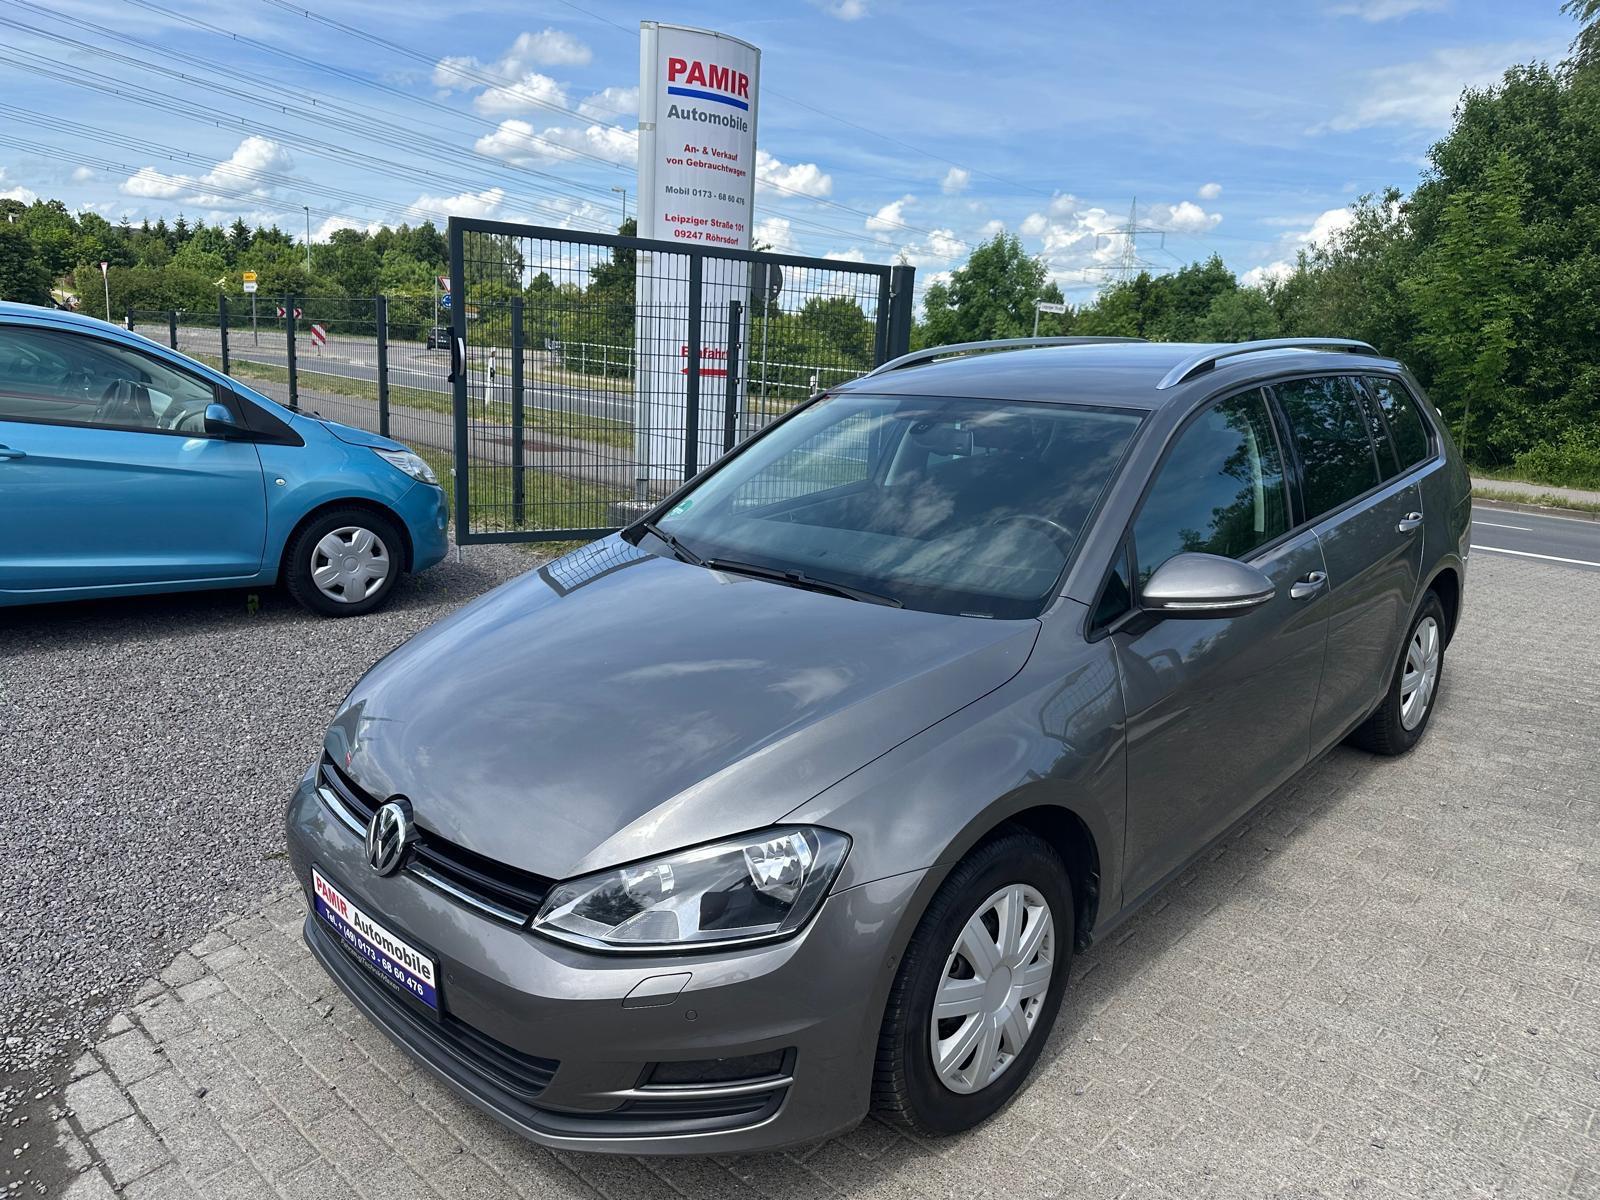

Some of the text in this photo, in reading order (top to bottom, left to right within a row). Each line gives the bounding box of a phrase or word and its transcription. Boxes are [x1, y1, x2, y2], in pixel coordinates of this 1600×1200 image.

[668, 57, 749, 100] PAMIR
[667, 104, 748, 133] Automobile
[684, 144, 738, 161] An- & Verkauf
[666, 157, 746, 177] von Gebrauchtwagen
[665, 185, 690, 196] Mobil
[692, 188, 712, 199] 0173
[718, 192, 727, 201] 68
[728, 195, 735, 203] 60
[665, 213, 744, 232] Leipziger Straße 101
[674, 229, 739, 245] 09247 Röhrsdorf
[316, 875, 431, 980] PAMIR Automobile
[343, 925, 357, 947] (49)
[358, 939, 376, 960] 0173
[382, 958, 393, 973] 68
[394, 967, 405, 982] 60
[406, 976, 424, 996] 476
